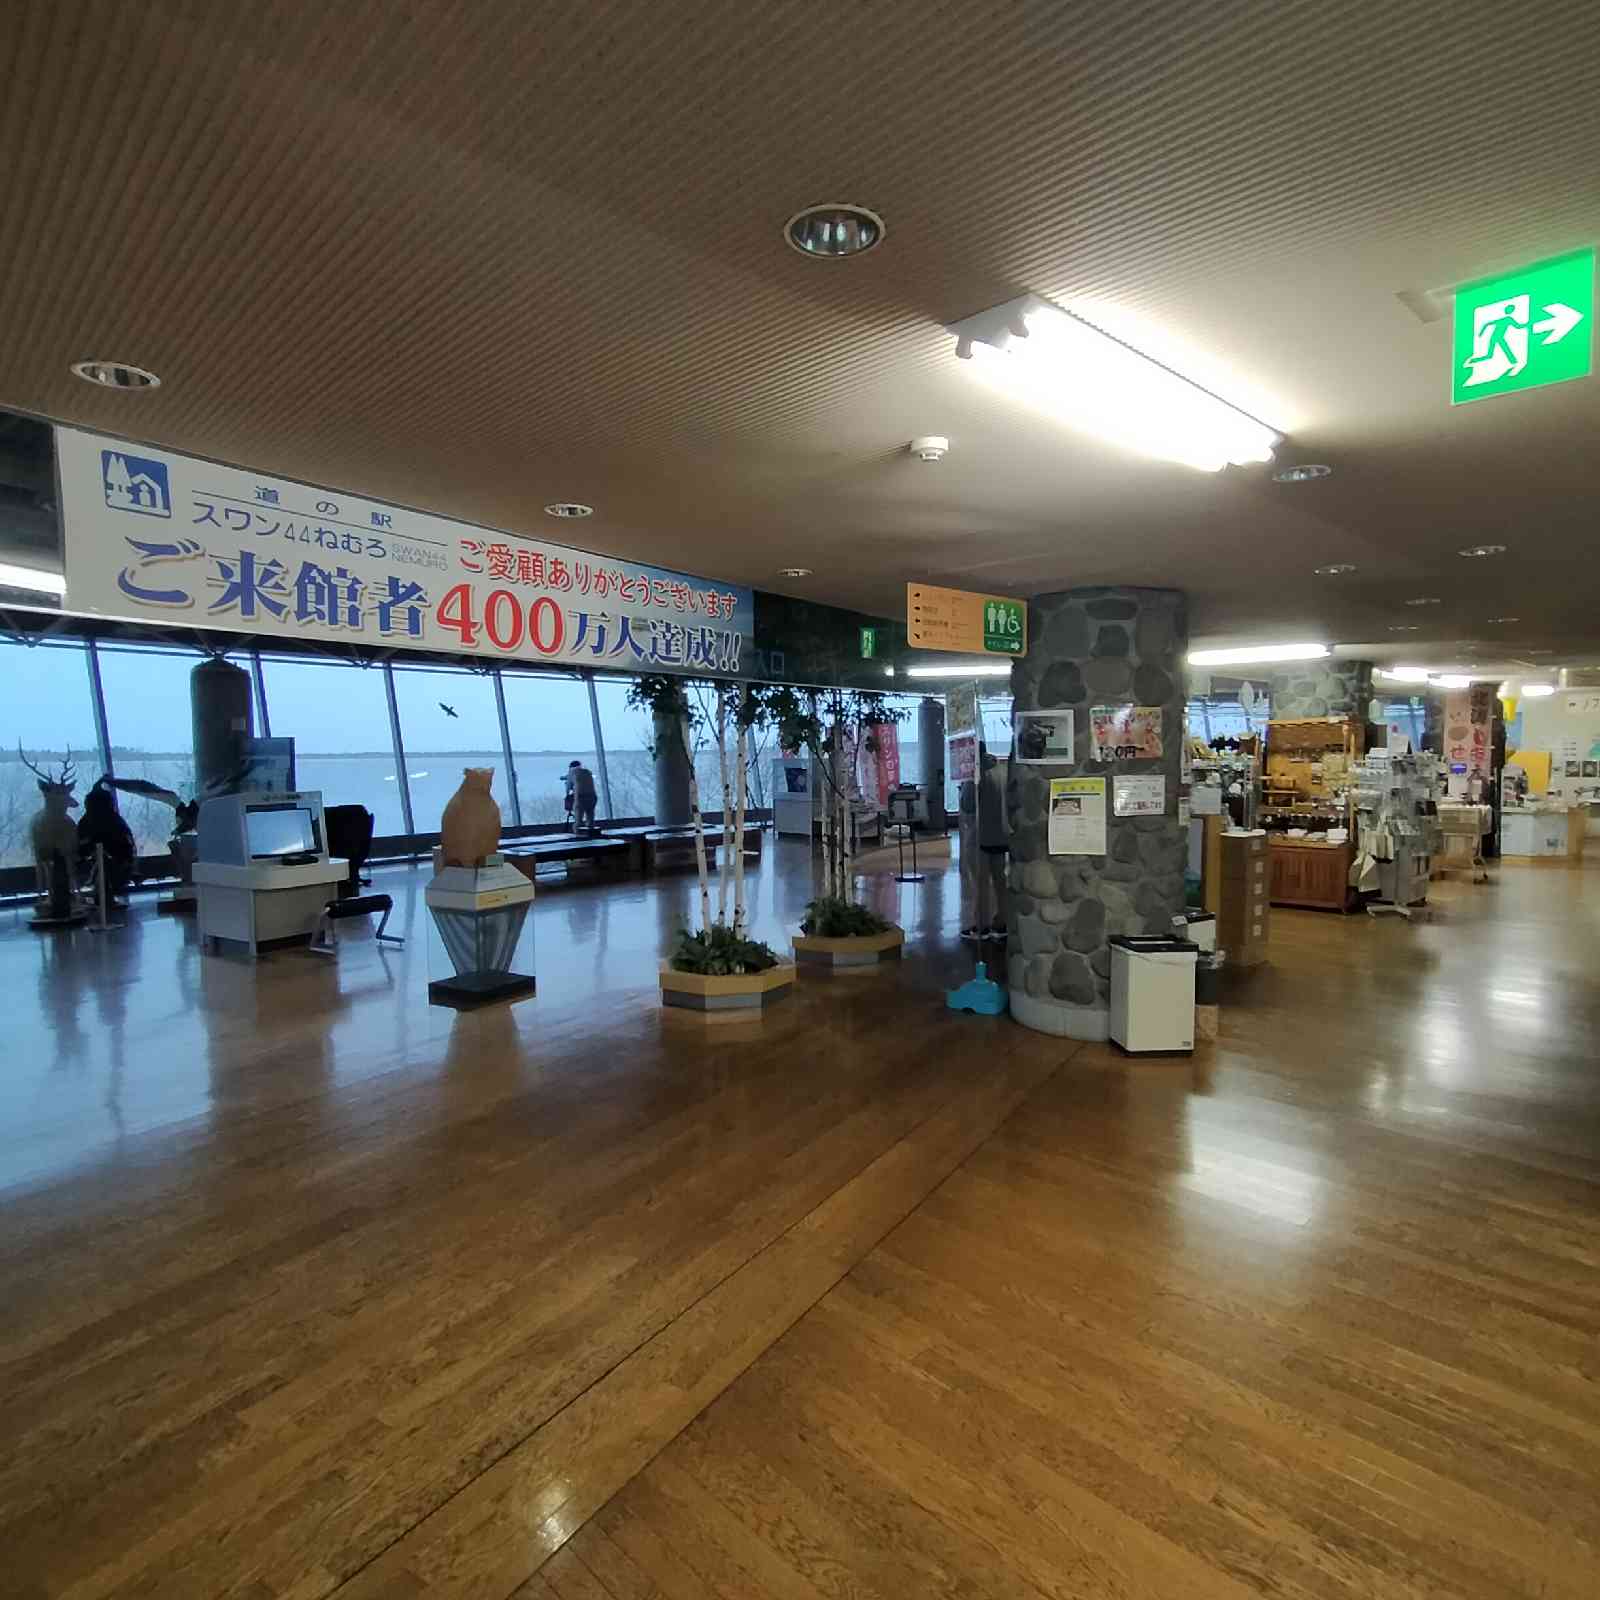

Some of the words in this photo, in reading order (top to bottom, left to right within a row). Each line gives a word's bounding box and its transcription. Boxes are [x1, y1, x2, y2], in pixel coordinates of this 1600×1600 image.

[192, 502, 387, 559] スワン44ねむろ
[254, 485, 392, 529] 道の駅
[459, 538, 738, 621] ご愛顧ありがとうございます
